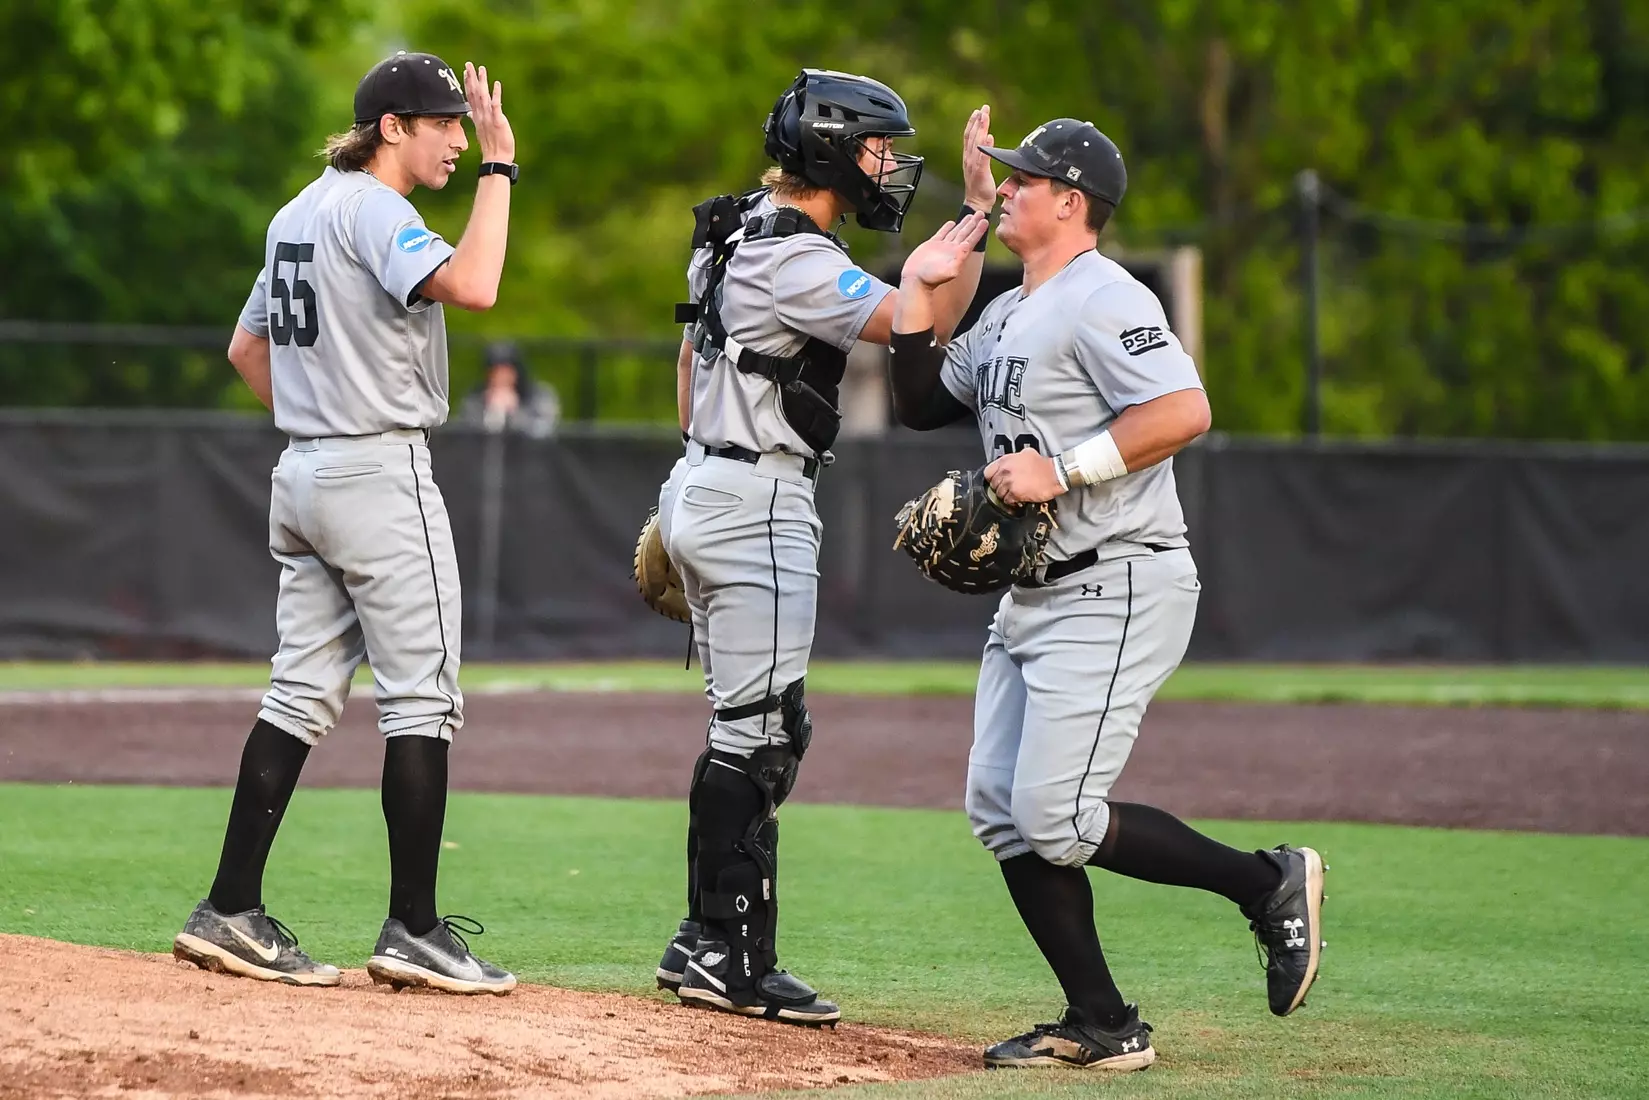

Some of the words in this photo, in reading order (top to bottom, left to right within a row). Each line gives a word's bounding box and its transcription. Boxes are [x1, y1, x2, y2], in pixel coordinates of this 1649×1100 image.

[402, 234, 429, 250] NCAA
[270, 241, 319, 347] 55
[846, 275, 869, 296] NCAA
